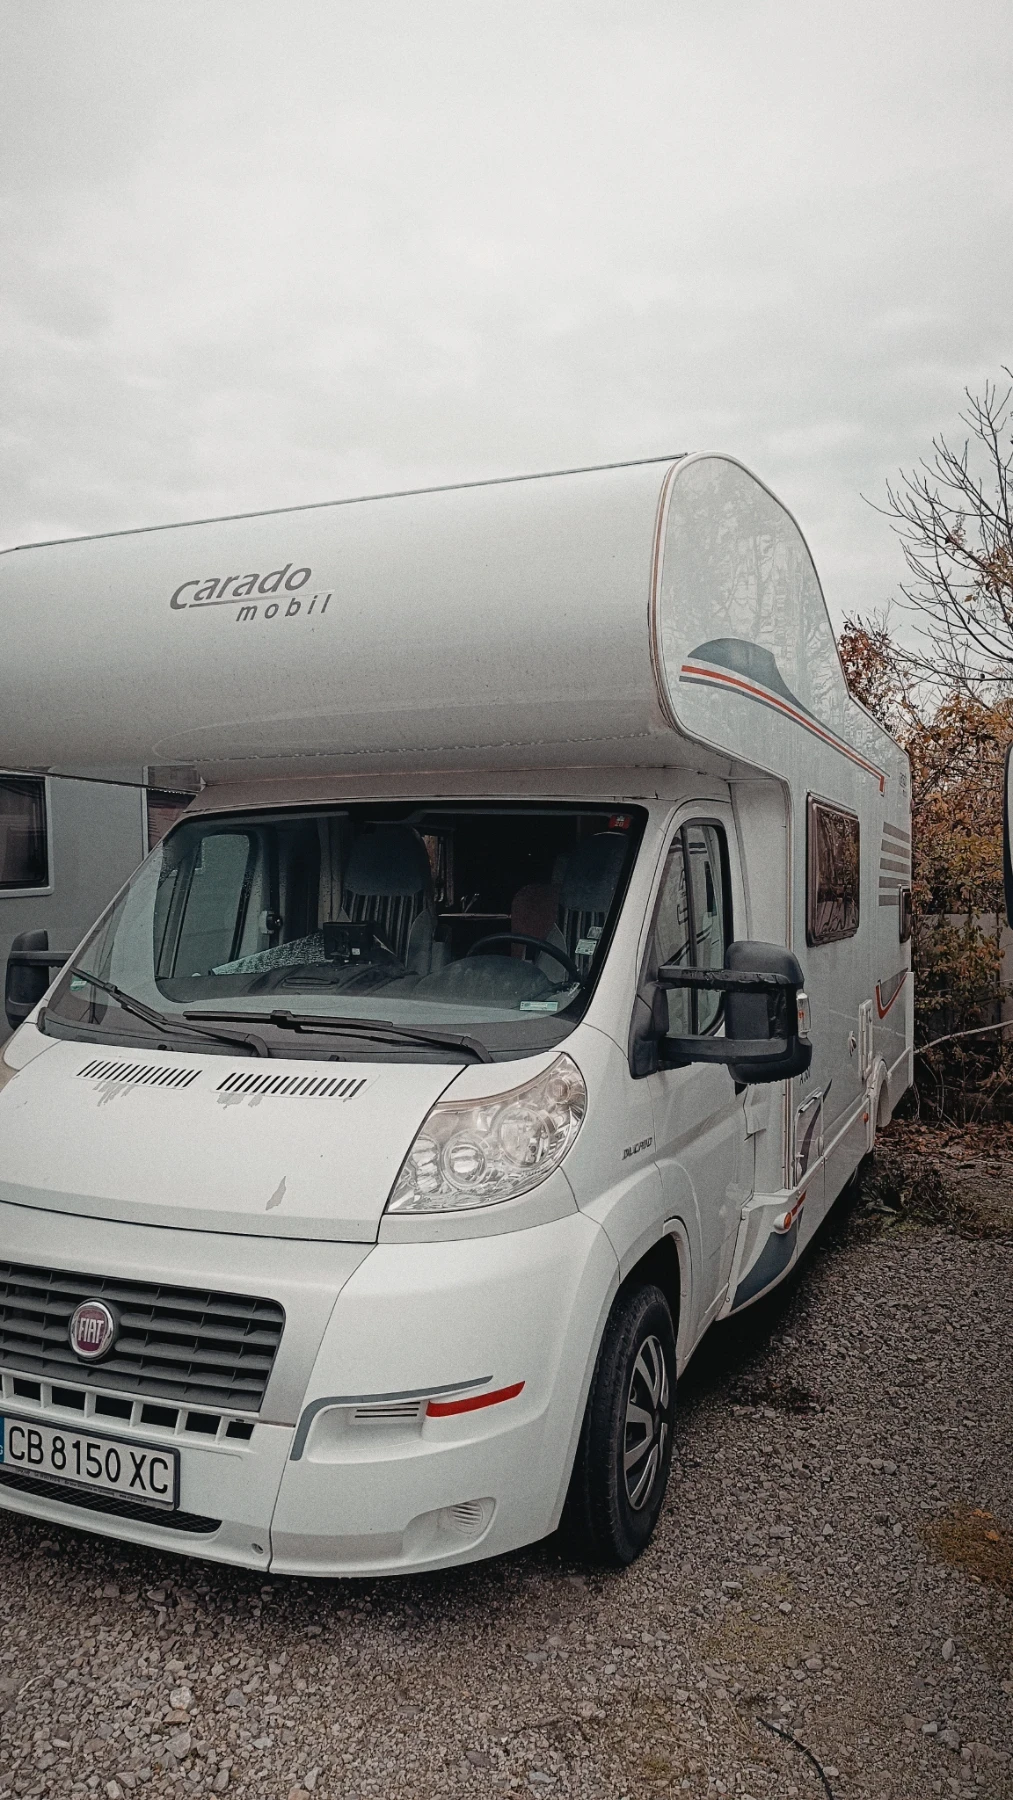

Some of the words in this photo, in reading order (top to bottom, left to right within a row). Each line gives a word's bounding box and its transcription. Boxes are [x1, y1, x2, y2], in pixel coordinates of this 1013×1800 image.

[169, 563, 312, 610] carado
[235, 594, 333, 622] mobil
[78, 1317, 105, 1344] FIAT
[9, 1425, 44, 1465] CB
[51, 1435, 121, 1483] 8150
[129, 1451, 169, 1494] XC
